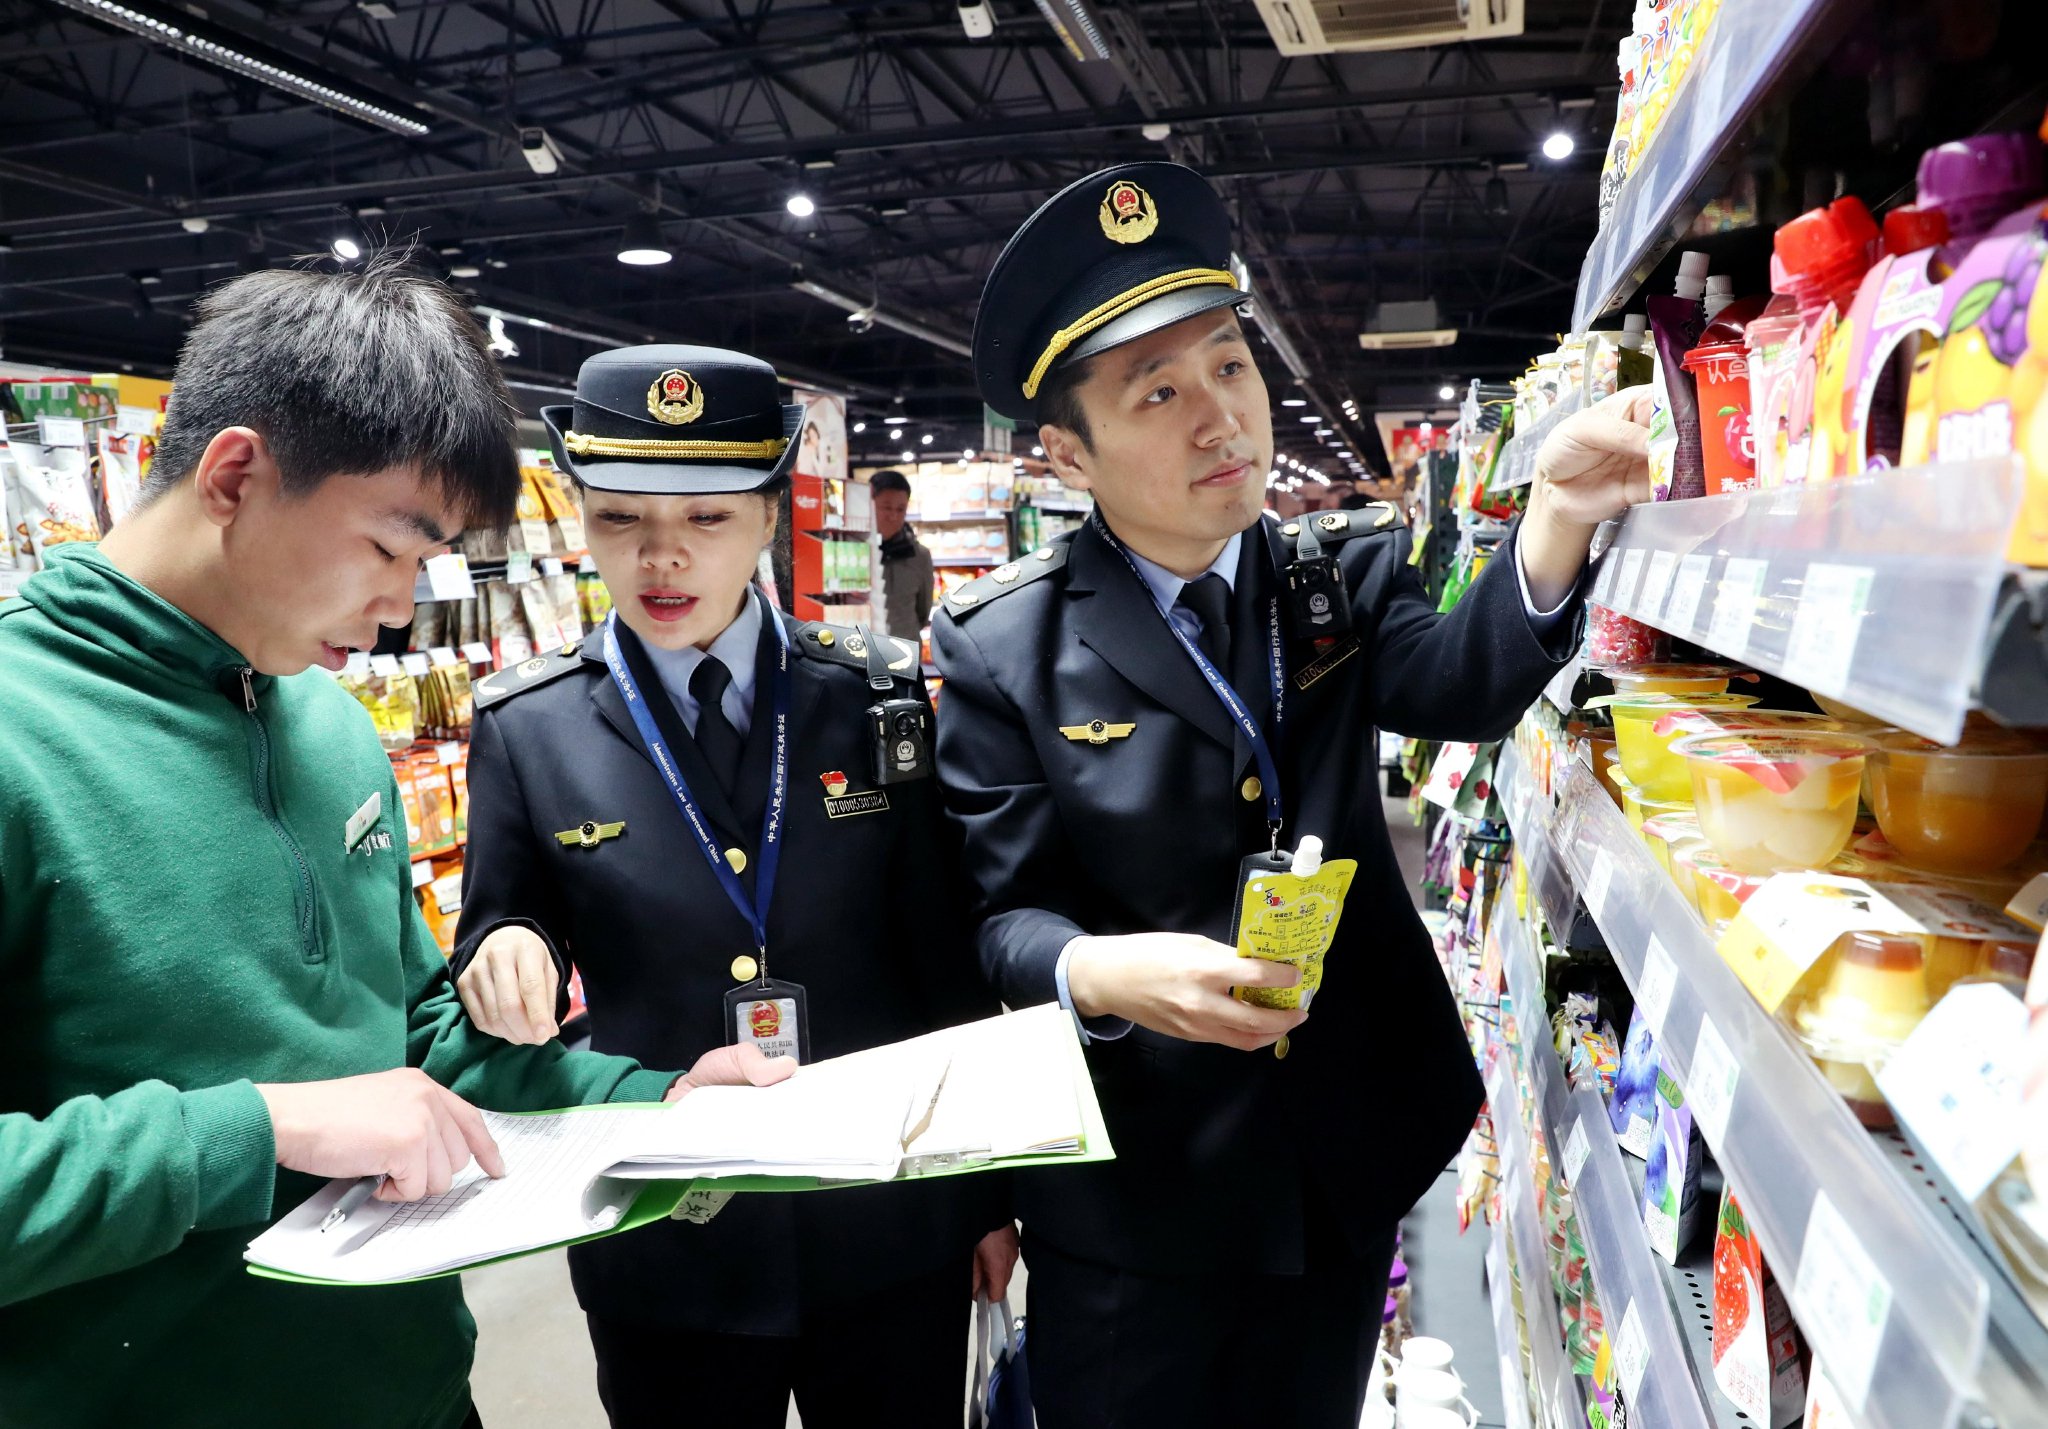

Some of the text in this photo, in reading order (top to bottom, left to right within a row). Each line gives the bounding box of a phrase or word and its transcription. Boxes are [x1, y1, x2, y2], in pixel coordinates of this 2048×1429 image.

[1205, 667, 1218, 681] Law
[1216, 681, 1245, 719] Enforcement
[1242, 718, 1257, 738] China
[1269, 596, 1285, 723] 中华人民共和国行政执法证
[652, 742, 721, 864] Administrative Law Enforcement China
[767, 713, 786, 843] 中华人民共和国行政执法证
